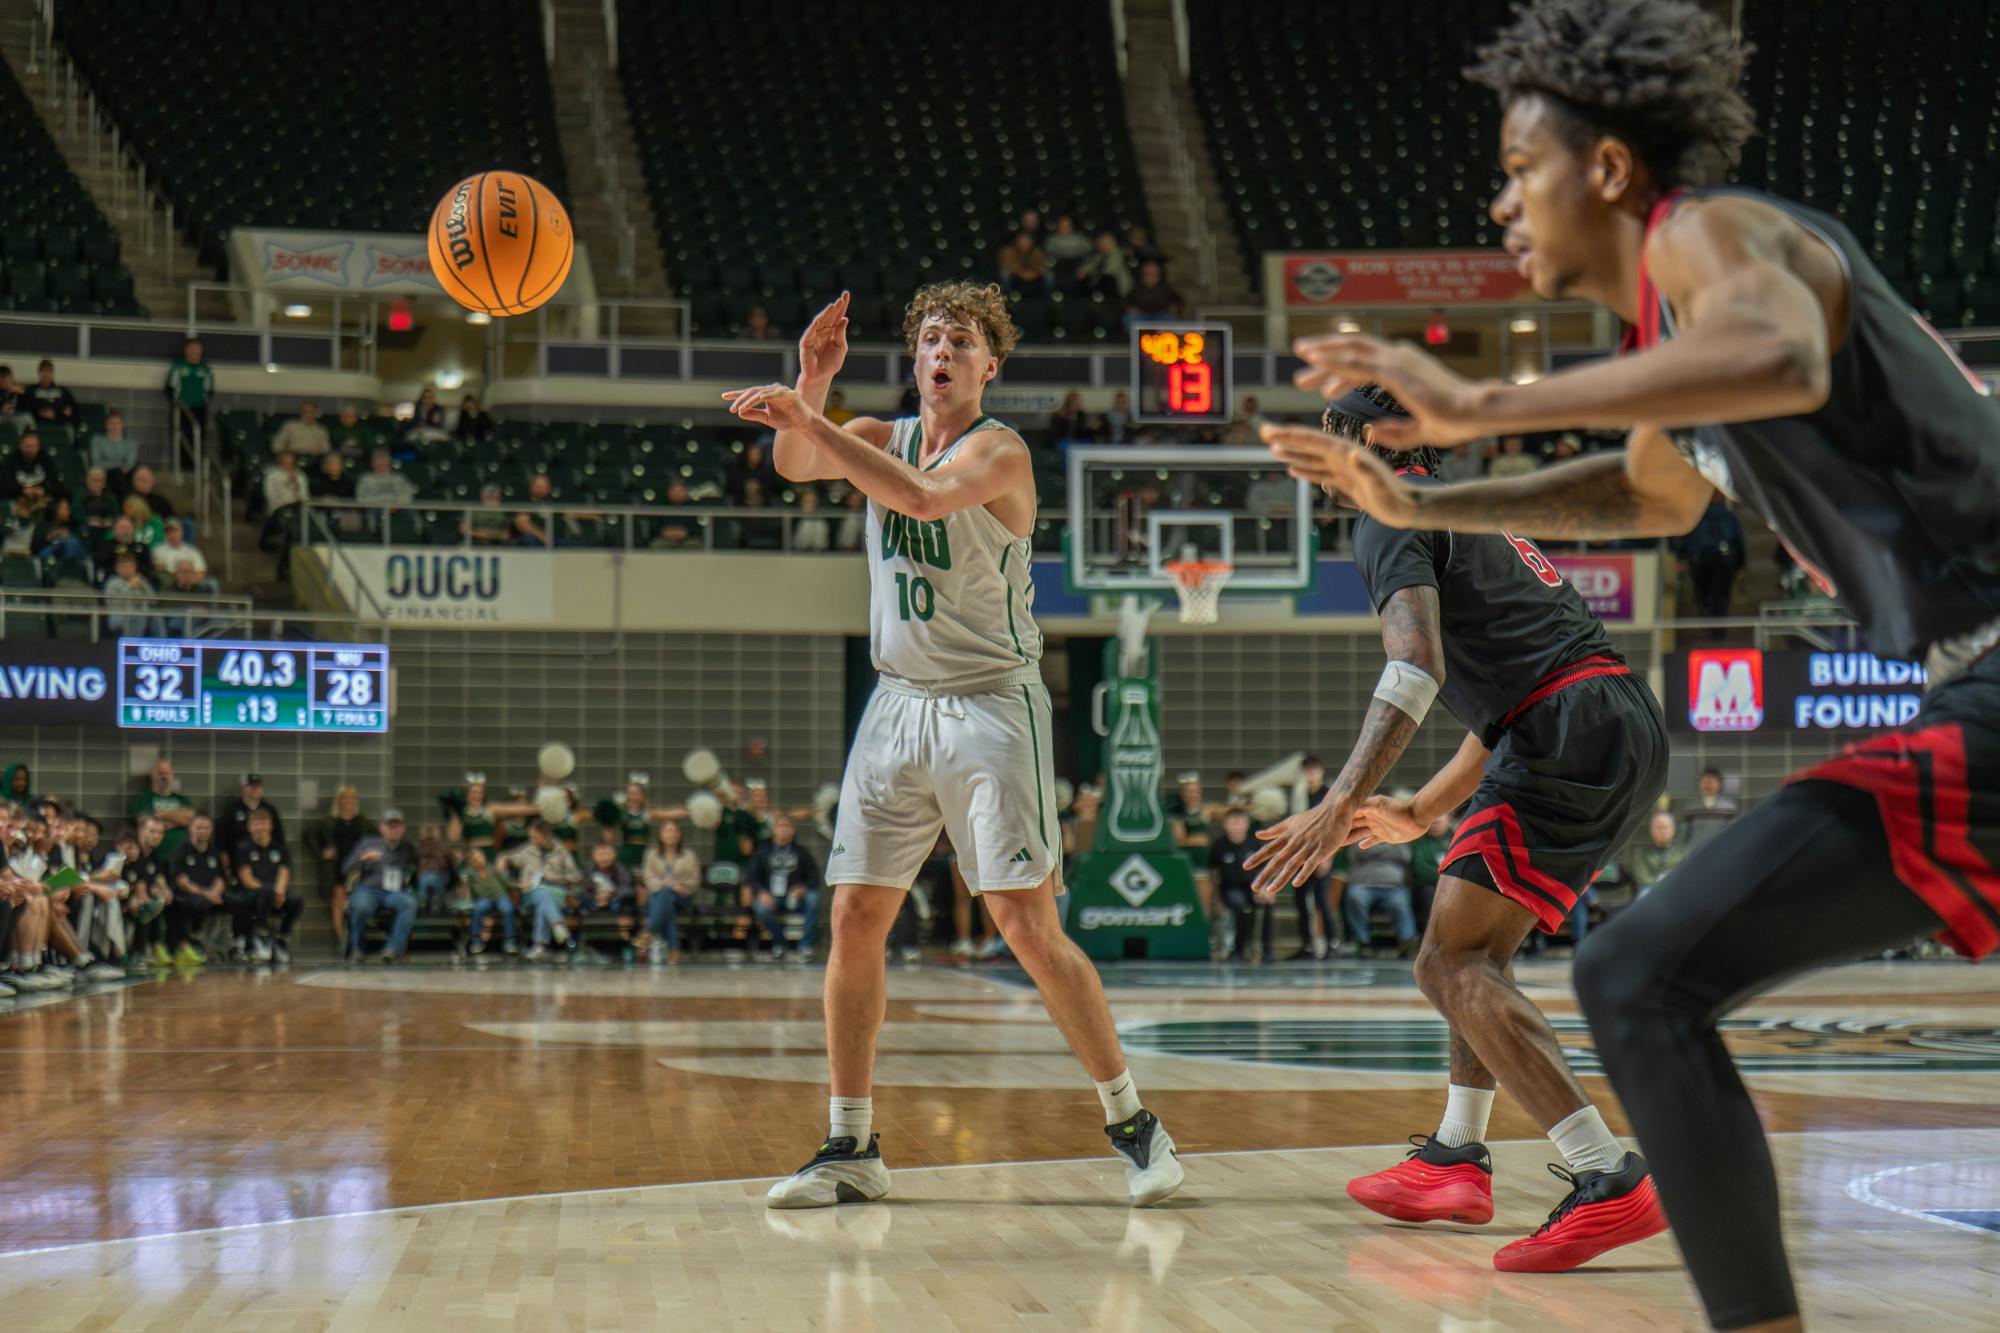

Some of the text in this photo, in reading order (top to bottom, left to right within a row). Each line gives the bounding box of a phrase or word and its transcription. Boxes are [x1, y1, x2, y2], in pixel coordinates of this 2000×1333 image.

[445, 180, 475, 271] Wilson
[272, 253, 340, 272] SONIC
[376, 257, 431, 275] SONI
[1169, 361, 1212, 413] 13
[385, 554, 500, 600] OUCU
[1561, 568, 1621, 598] ED
[895, 572, 935, 622] 10
[385, 606, 500, 621] FINANCIAL
[138, 646, 182, 662] OHIO
[218, 649, 296, 687] 40.3
[136, 665, 183, 701] 32
[327, 670, 373, 706] 28
[145, 706, 189, 722] FOULS
[335, 711, 377, 726] FOULS
[1123, 870, 1147, 891] G
[1079, 906, 1188, 930] gomart
